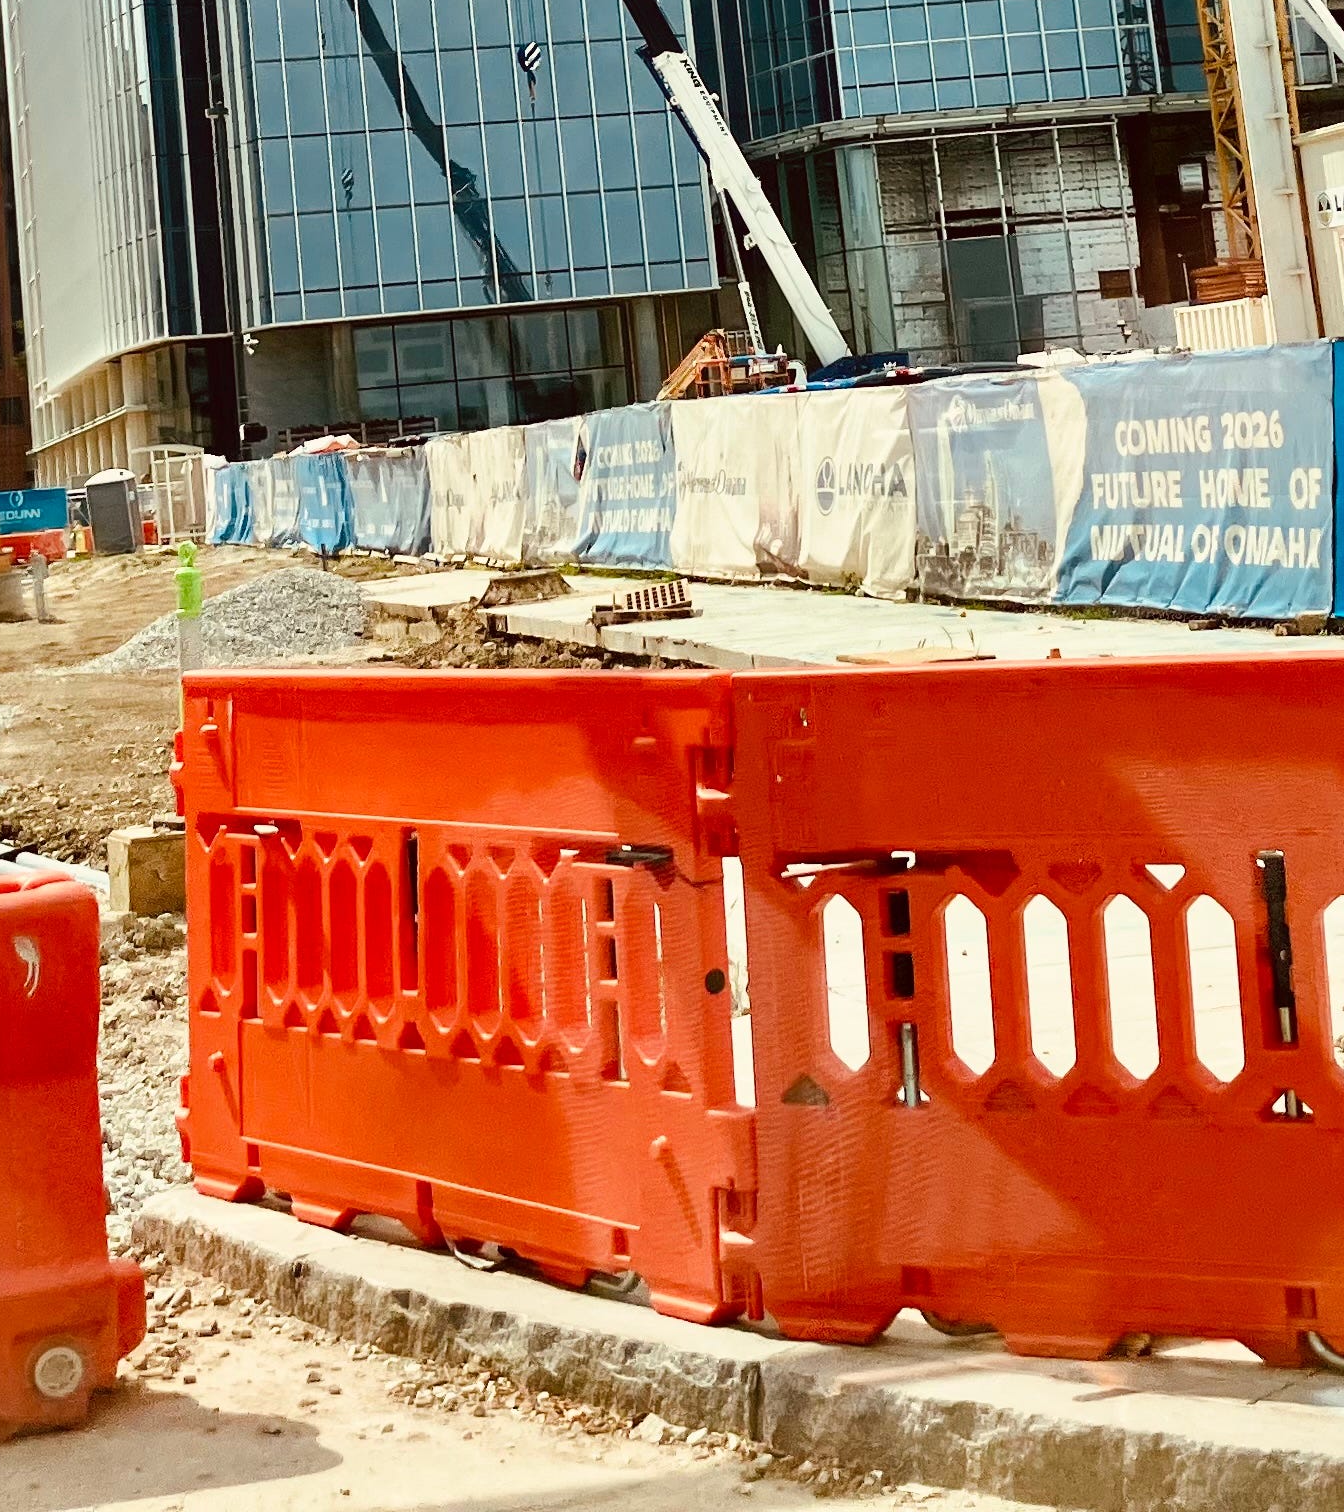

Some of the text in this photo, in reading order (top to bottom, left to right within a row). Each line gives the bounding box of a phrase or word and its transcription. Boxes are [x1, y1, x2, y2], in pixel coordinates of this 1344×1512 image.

[680, 58, 702, 88] KING
[1114, 409, 1285, 457] COMING 2026
[1091, 468, 1322, 510] FUTURE HOME OF
[1091, 524, 1185, 563] MUTUAL
